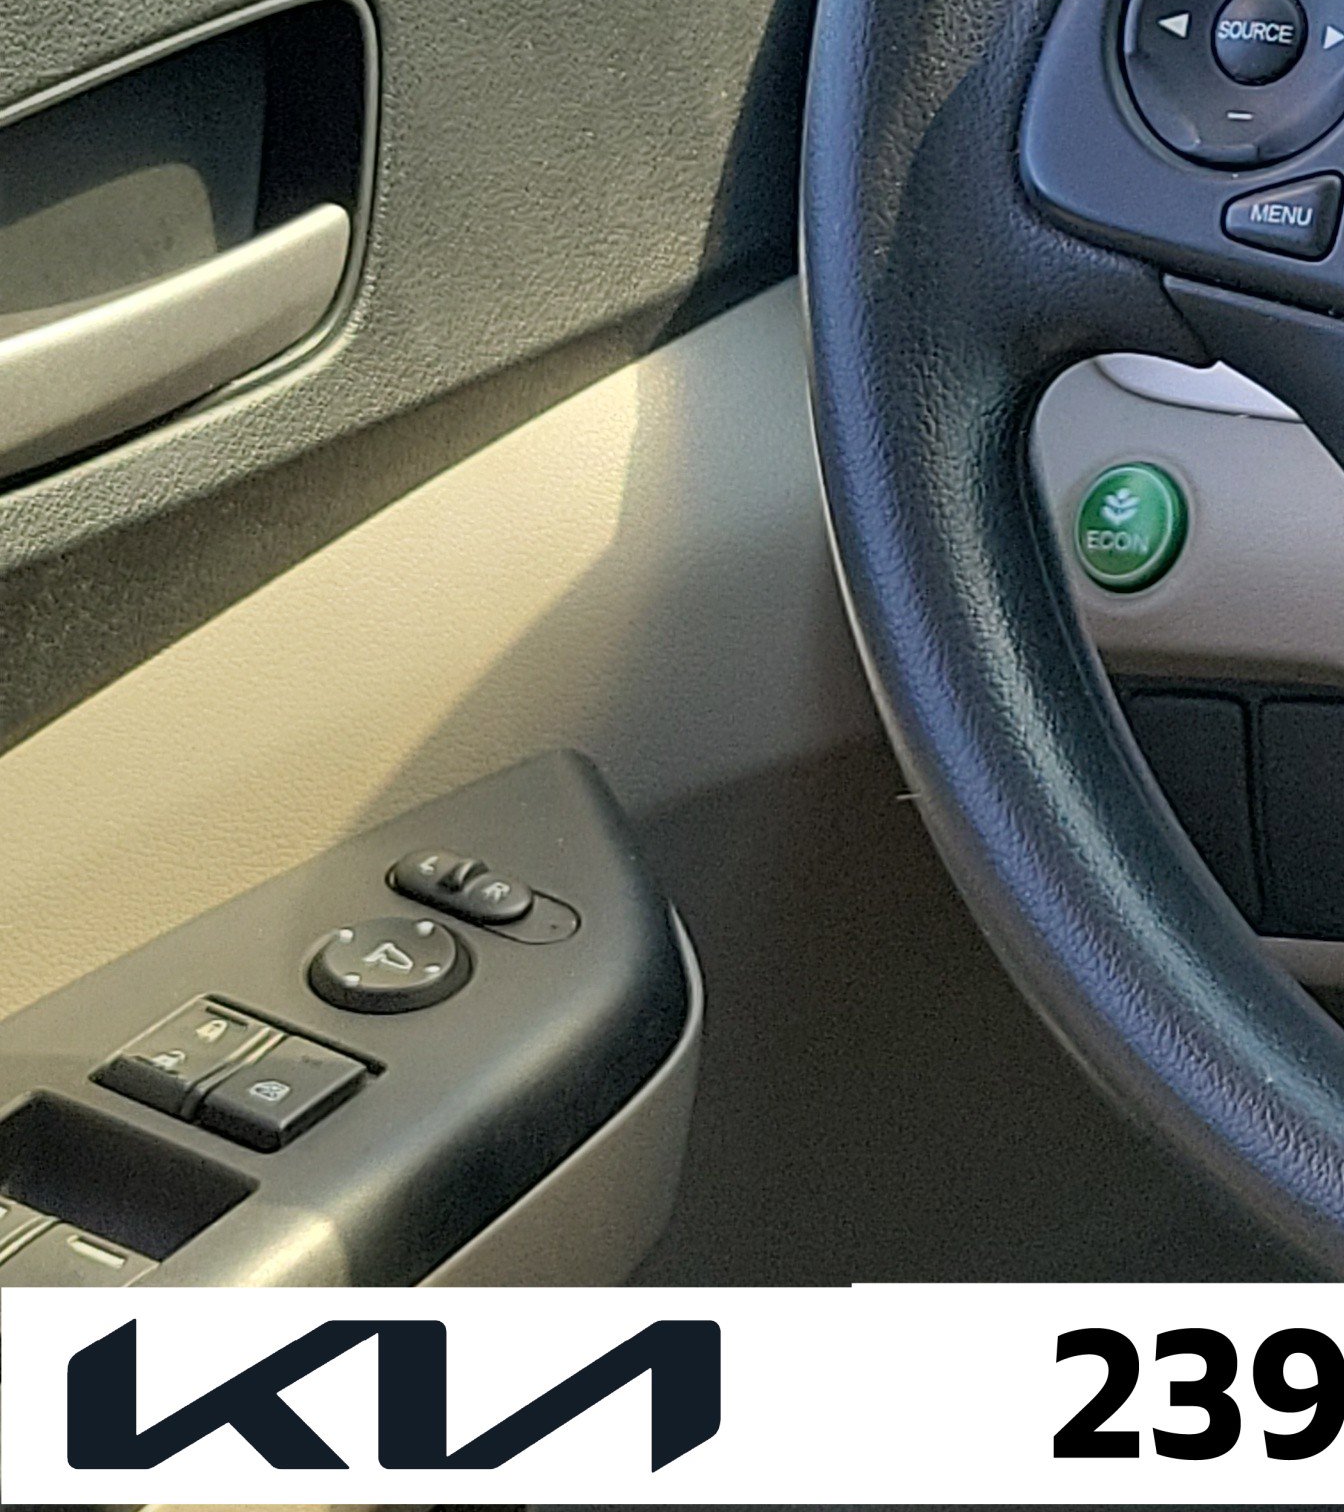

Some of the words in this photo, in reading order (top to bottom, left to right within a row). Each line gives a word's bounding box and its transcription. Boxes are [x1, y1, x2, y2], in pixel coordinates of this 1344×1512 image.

[1218, 21, 1292, 42] SOURCE
[1250, 203, 1312, 227] MENU
[1087, 529, 1149, 552] ECON
